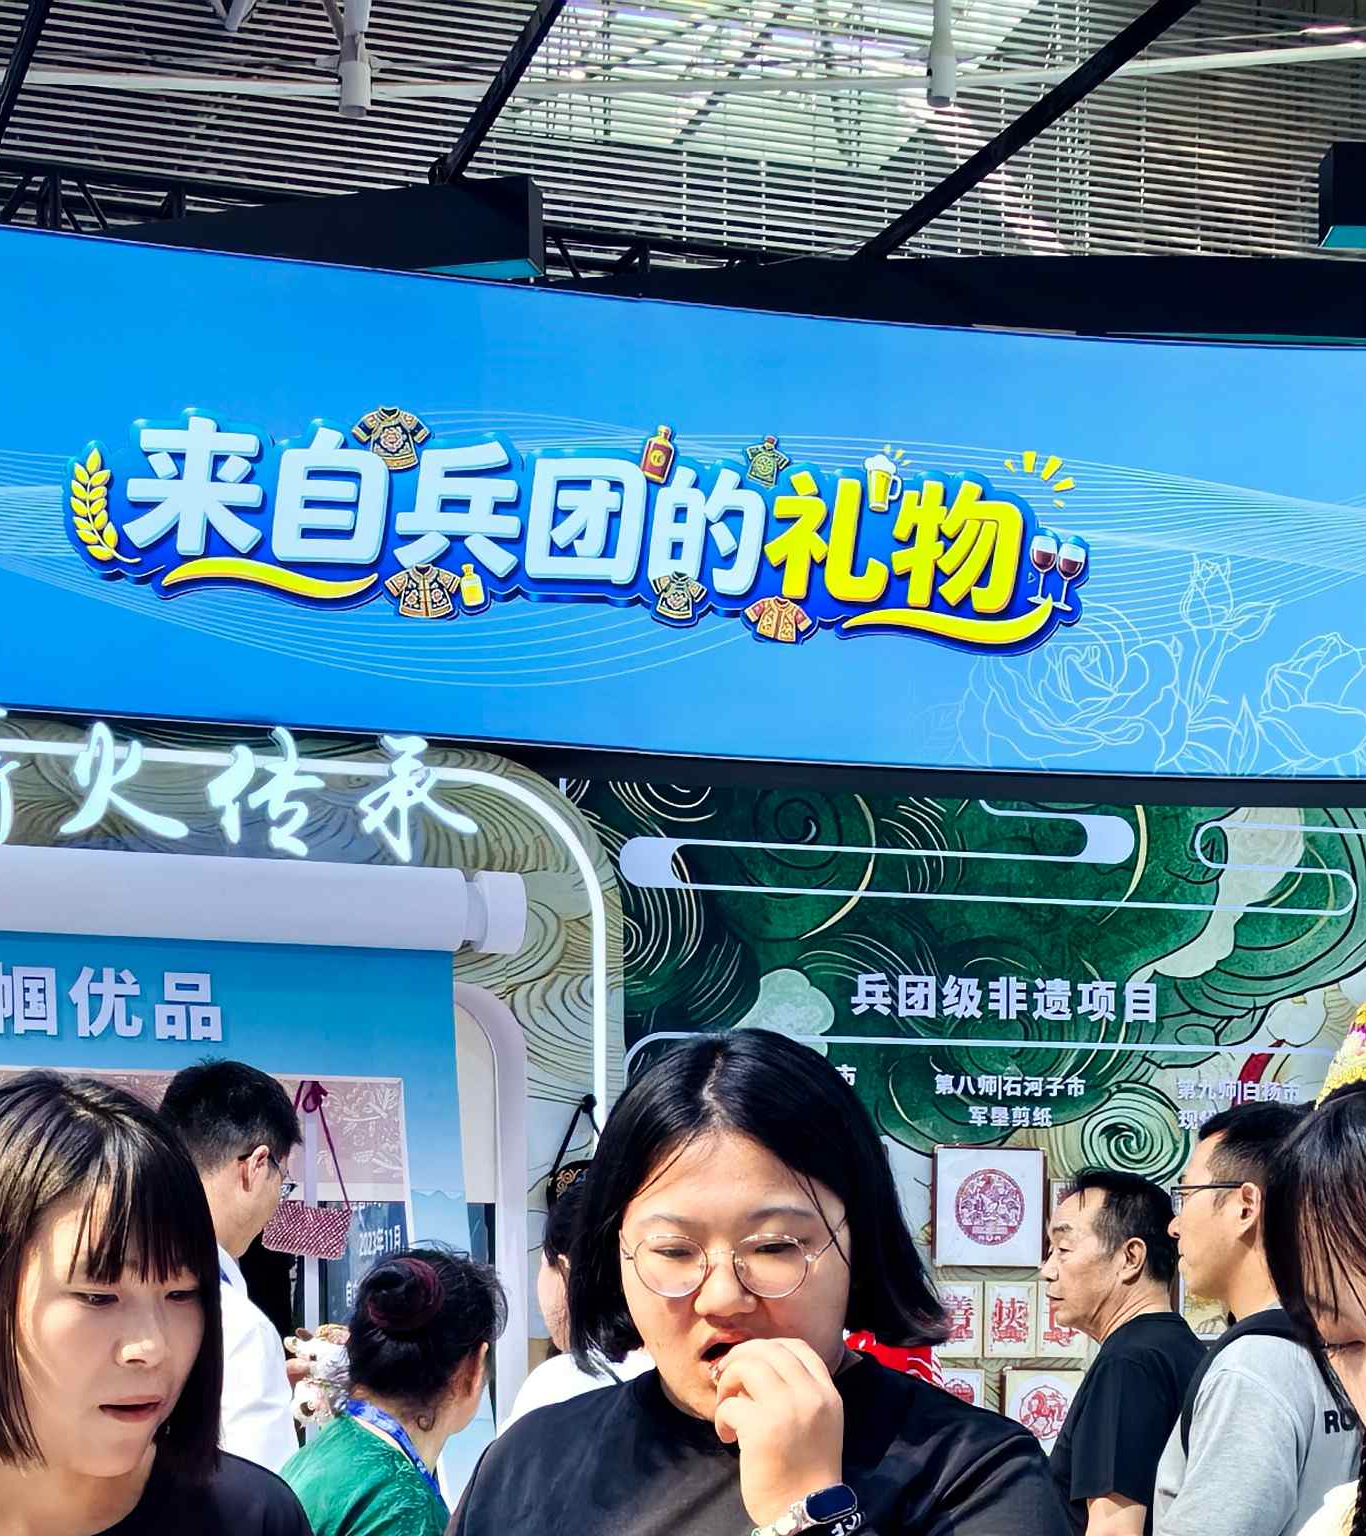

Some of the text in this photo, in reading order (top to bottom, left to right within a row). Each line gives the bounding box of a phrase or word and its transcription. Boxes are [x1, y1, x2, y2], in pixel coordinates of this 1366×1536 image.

[123, 416, 1023, 616] 来自兵团的礼物
[851, 972, 1159, 1023] 兵团级非遗项目
[935, 1073, 1087, 1099] 第八师|石河子市
[968, 1106, 1053, 1128] 军垦剪纸
